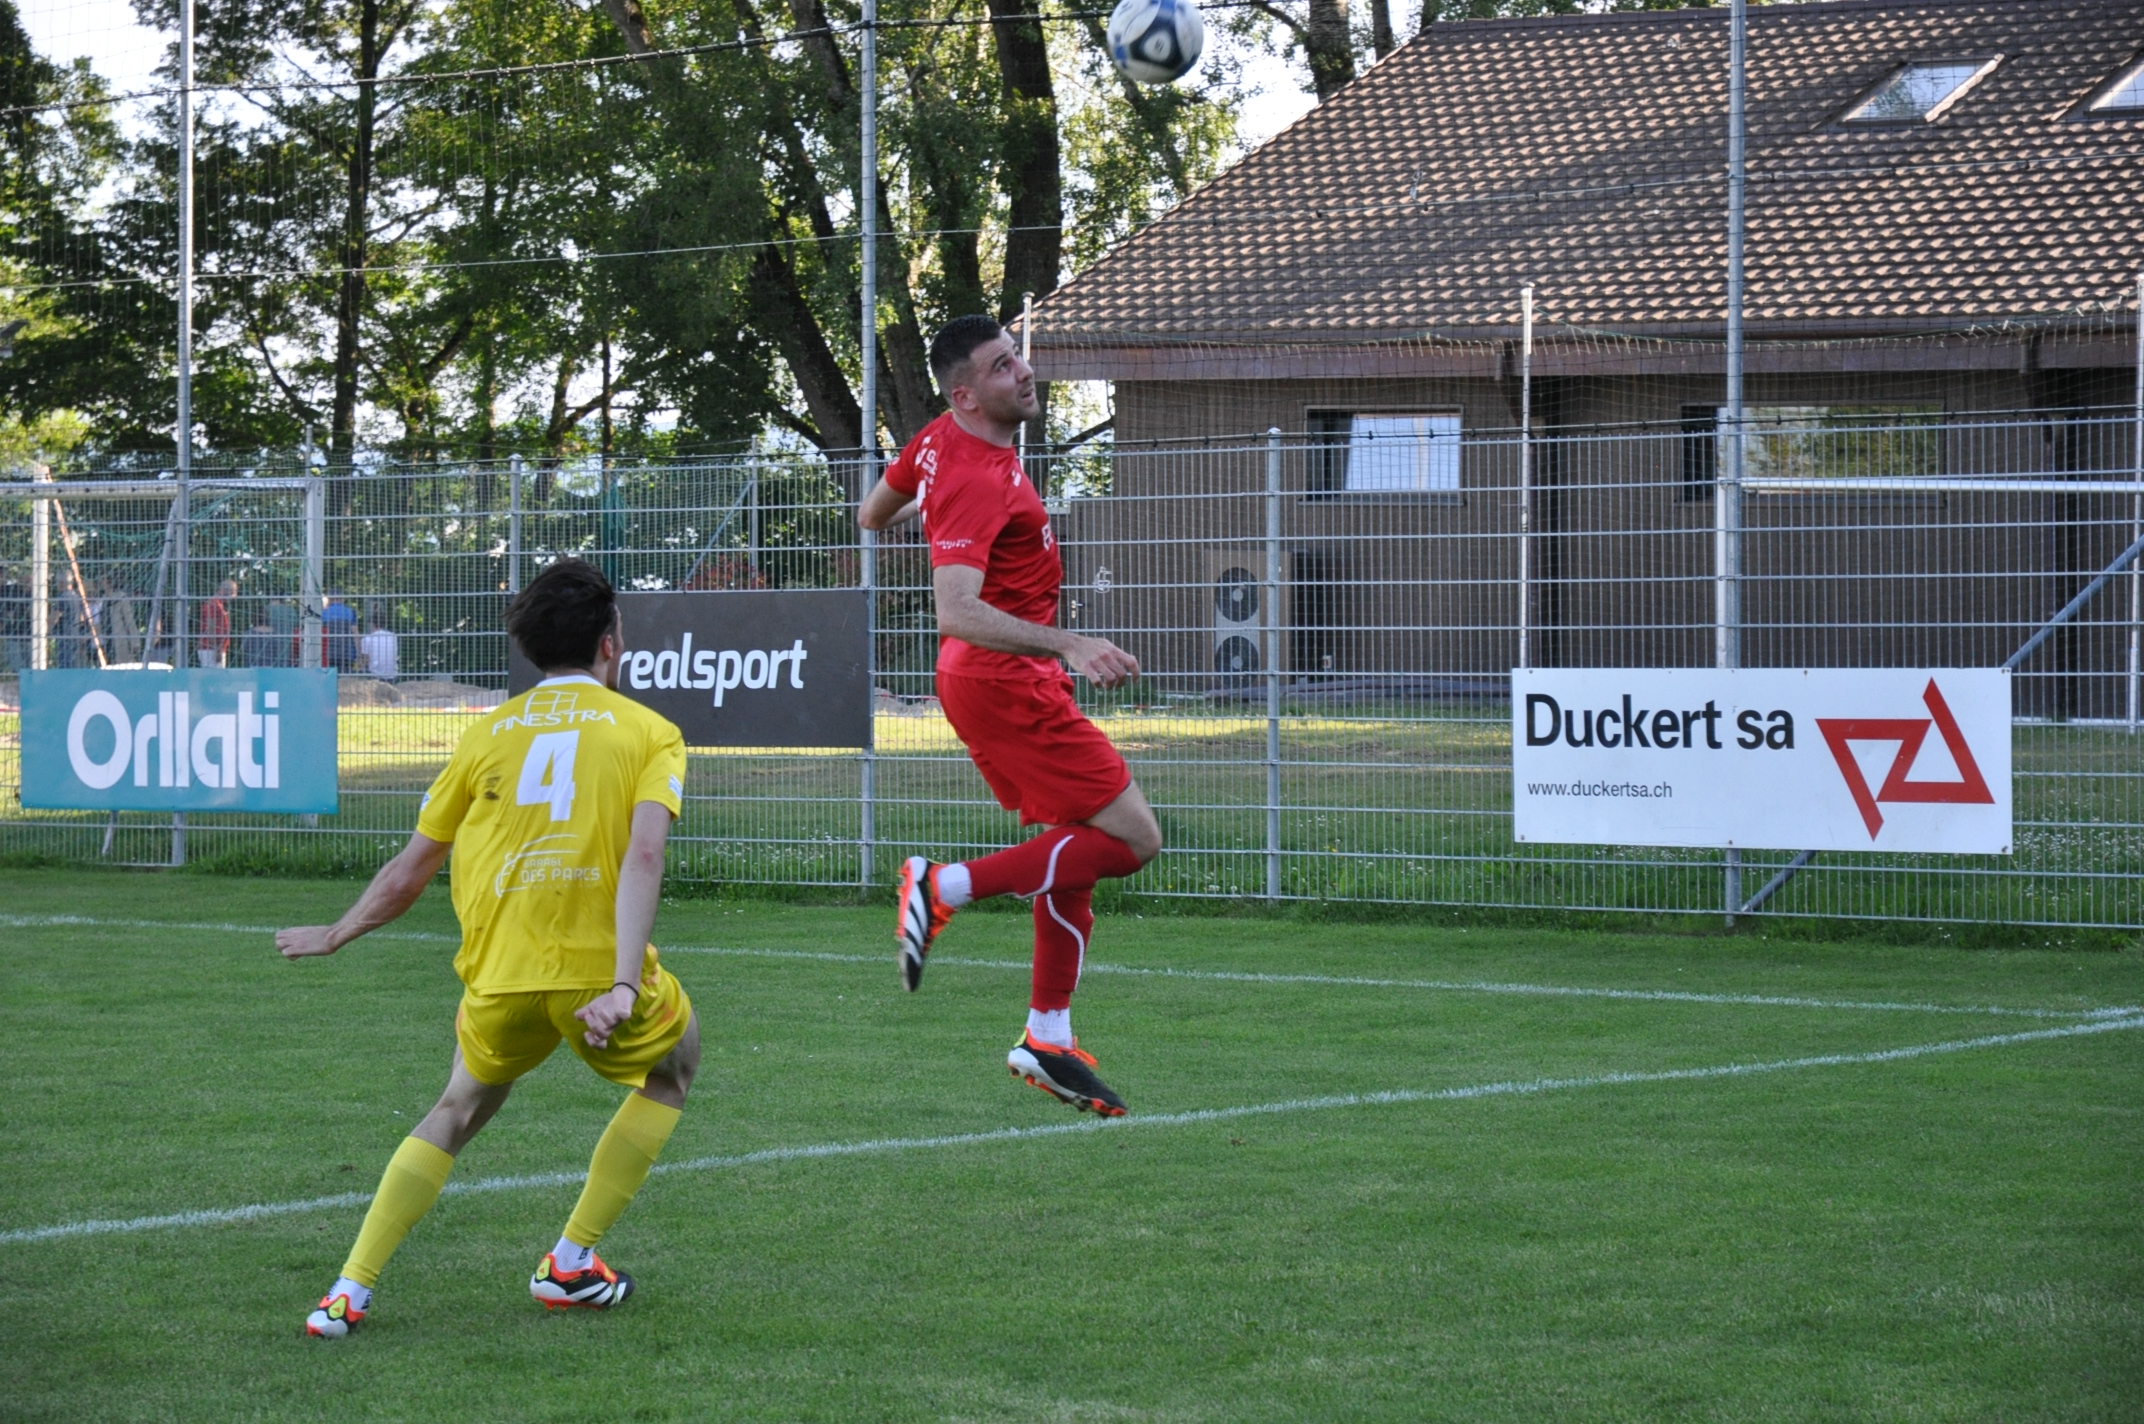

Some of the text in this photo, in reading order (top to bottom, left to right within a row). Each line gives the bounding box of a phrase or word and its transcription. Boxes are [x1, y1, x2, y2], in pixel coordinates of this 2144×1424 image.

[617, 632, 807, 707] realsport
[67, 690, 279, 789] Orllati
[492, 709, 617, 736] FINESTRA
[1526, 694, 1795, 750] Duckert sa
[516, 730, 580, 821] 4
[1527, 780, 1673, 797] www.duckertsa.ch
[521, 869, 546, 883] DES
